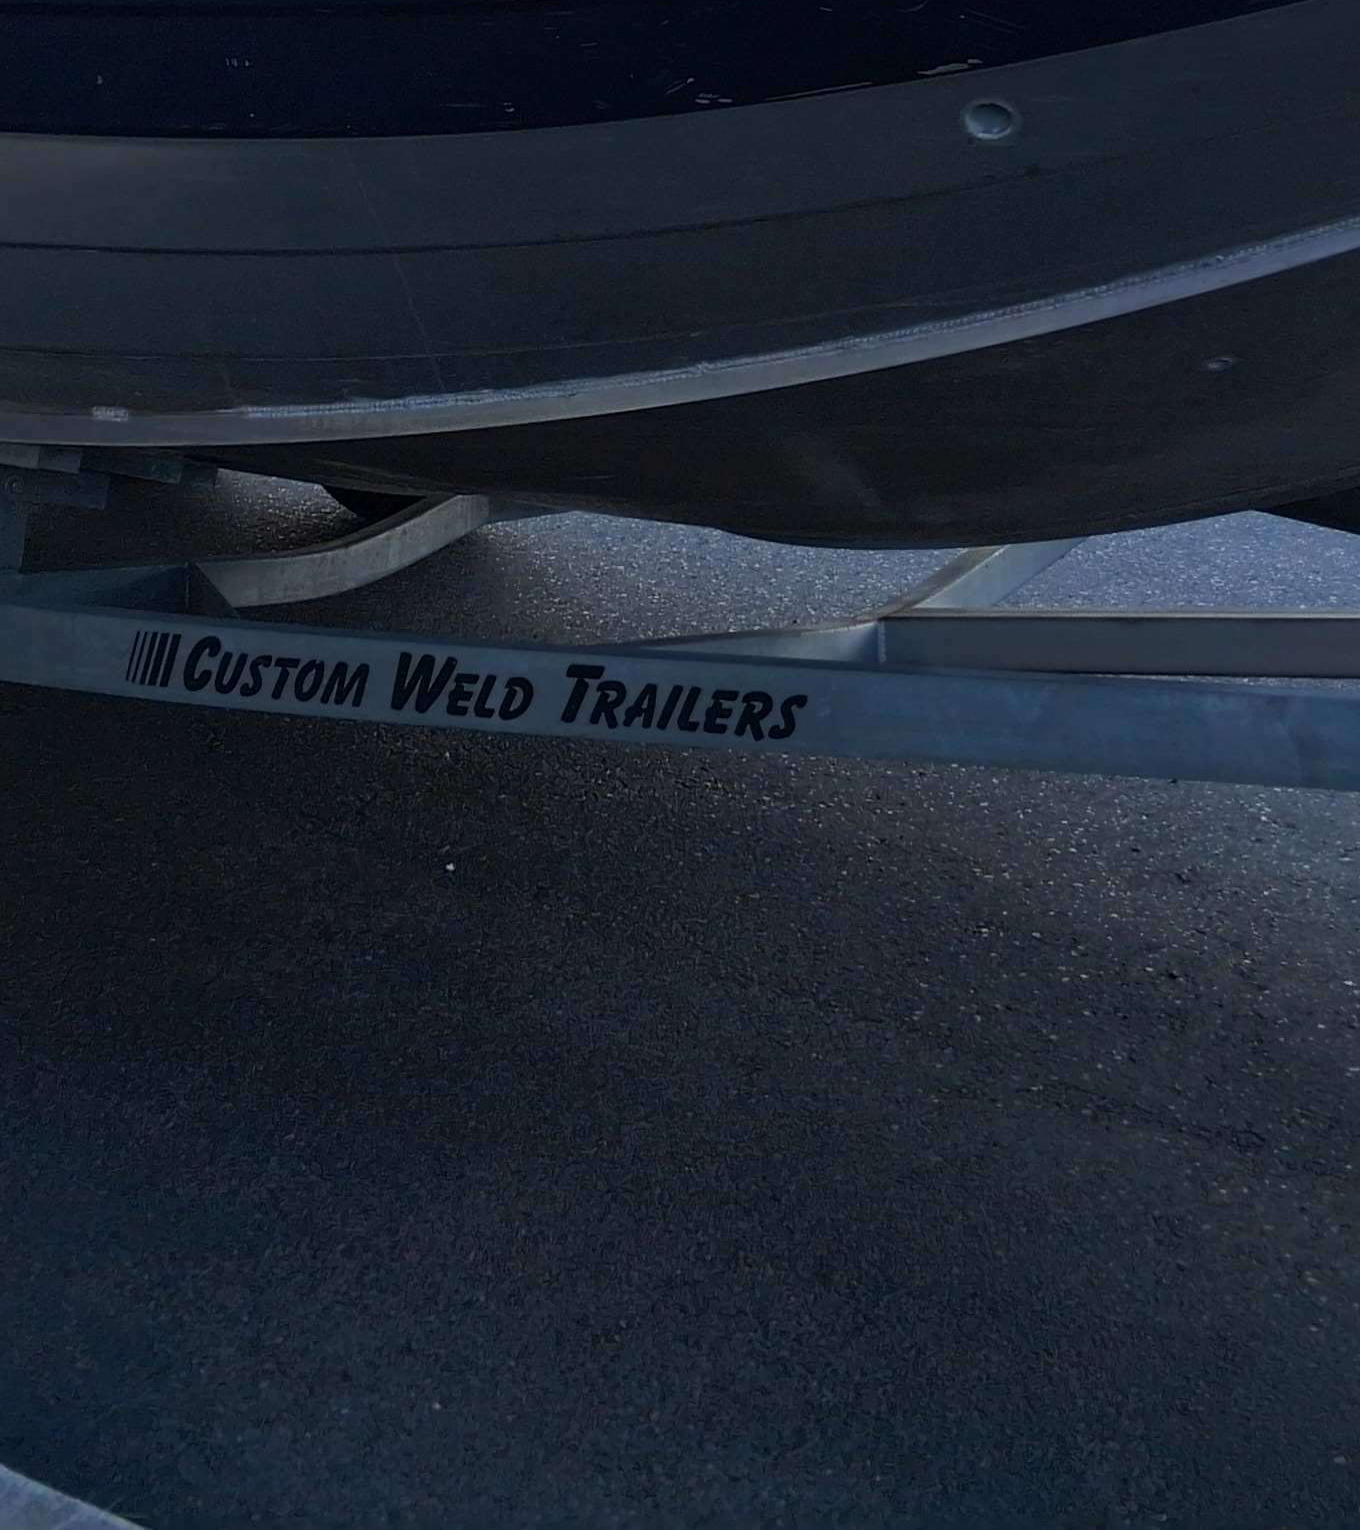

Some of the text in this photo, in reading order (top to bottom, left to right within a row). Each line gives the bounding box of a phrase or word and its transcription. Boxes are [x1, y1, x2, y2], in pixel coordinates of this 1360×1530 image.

[184, 635, 809, 742] CUSTOM WELD TRAILERS
